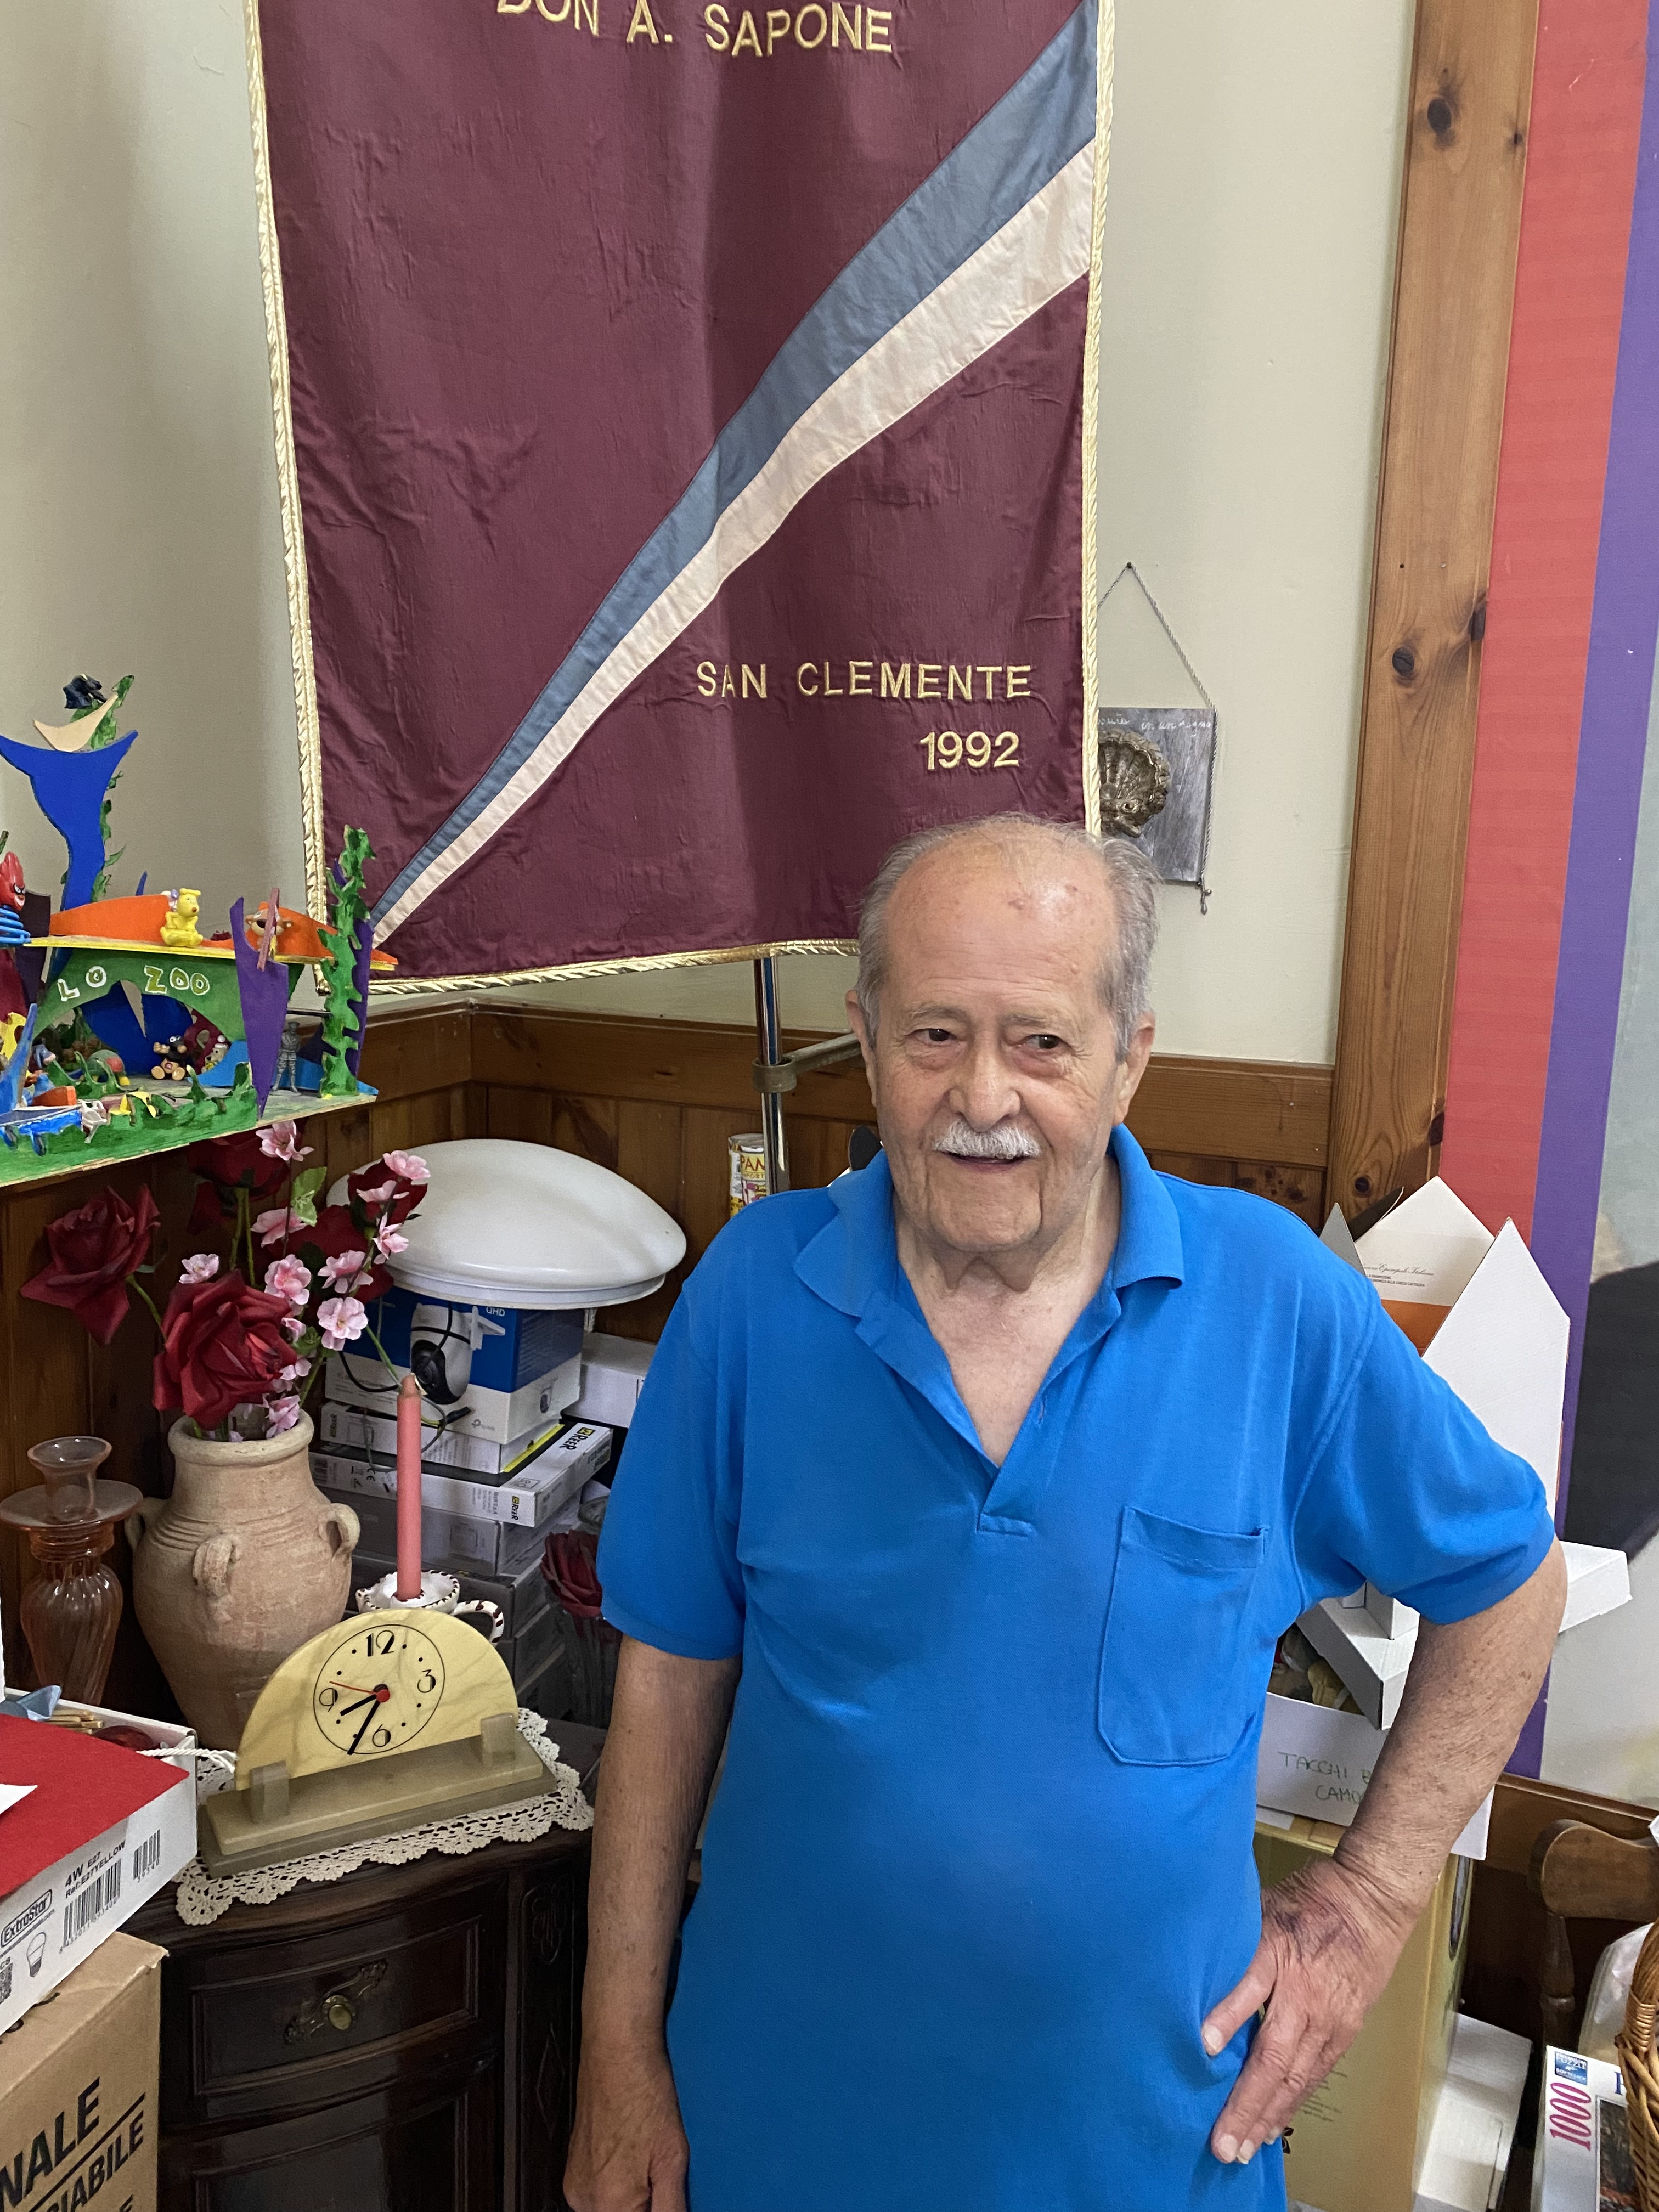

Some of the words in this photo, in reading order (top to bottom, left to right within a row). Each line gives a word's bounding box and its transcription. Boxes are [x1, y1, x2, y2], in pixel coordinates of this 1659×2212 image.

[496, 0, 600, 36] ON
[625, 0, 673, 43] A.
[703, 2, 893, 57] SAPONE
[696, 661, 767, 698] SAN
[797, 661, 1031, 701] CLEMENTE
[919, 731, 1019, 771] 1992
[144, 964, 210, 996] ZOO
[486, 1306, 505, 1317] QHD
[558, 1434, 589, 1450] REER
[366, 1630, 394, 1657] 12
[417, 1669, 436, 1693] 3
[319, 1688, 338, 1712] 9
[372, 1724, 391, 1747] 6
[65, 1864, 83, 1887] 4W
[87, 1851, 101, 1868] E27
[4, 1894, 49, 1943] ExtraStar
[1549, 2083, 1592, 2152] 1000
[47, 2110, 144, 2212] IABILE
